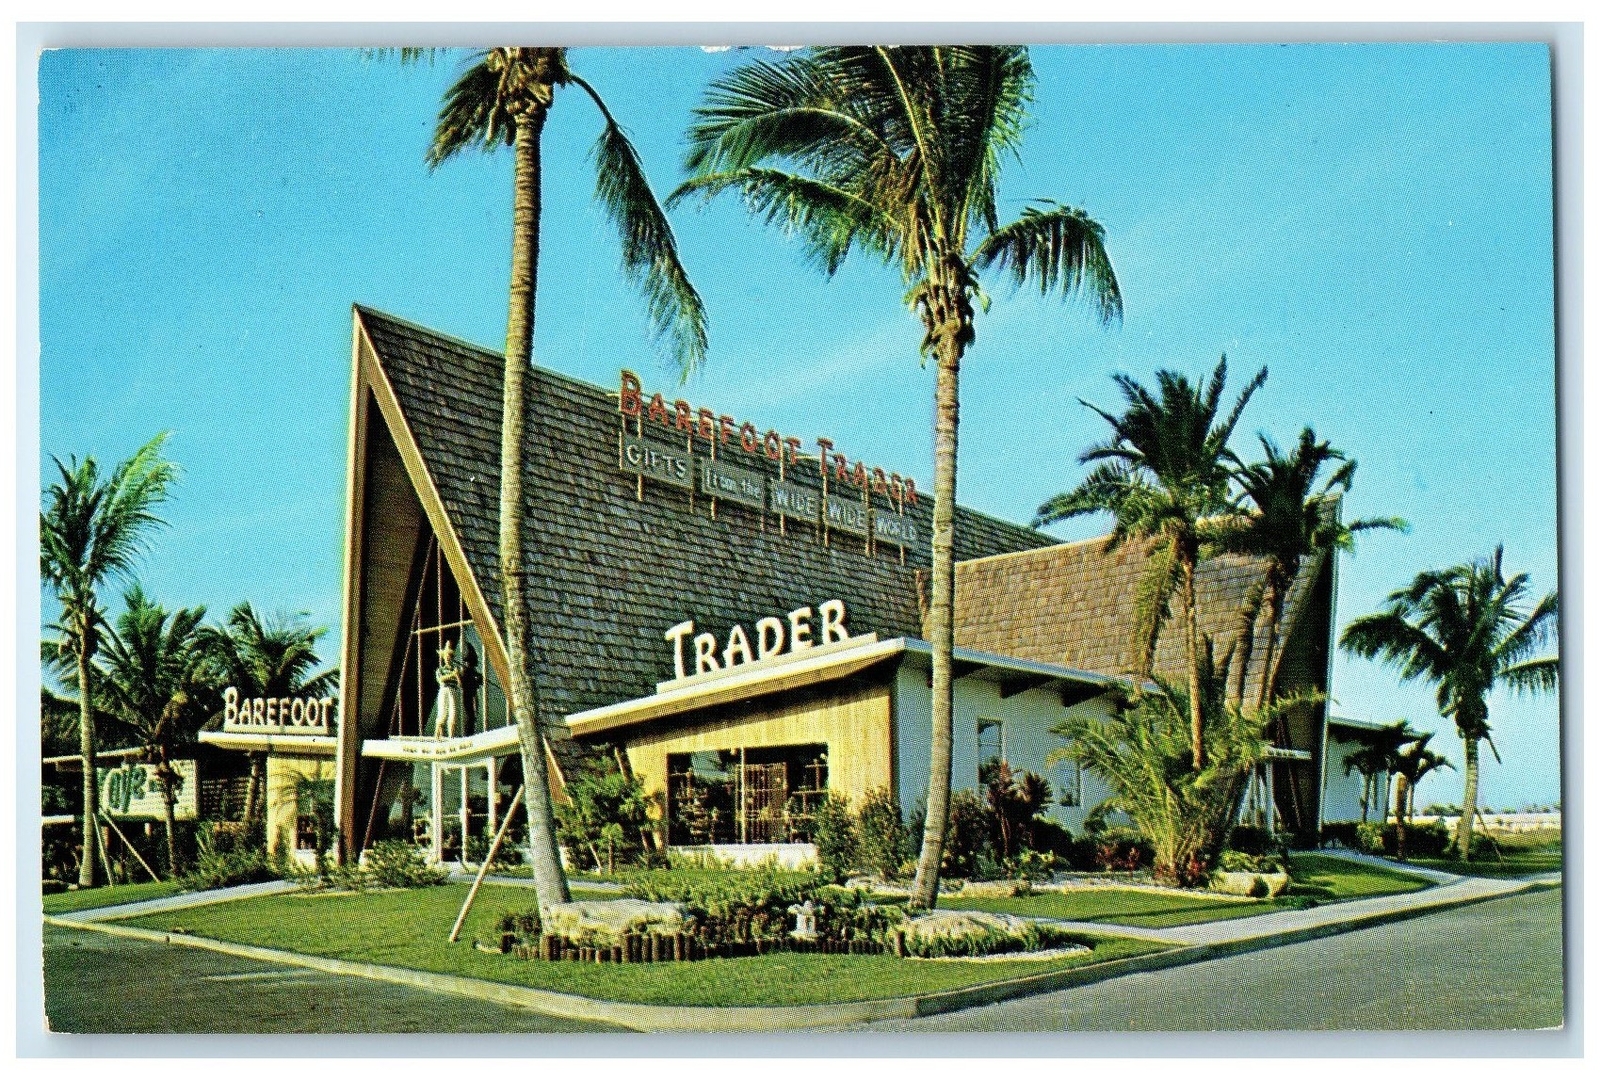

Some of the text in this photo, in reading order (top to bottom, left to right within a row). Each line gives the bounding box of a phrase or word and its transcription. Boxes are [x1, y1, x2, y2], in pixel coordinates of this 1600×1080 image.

[620, 369, 919, 505] BAREFOOT TRADER
[627, 444, 687, 478] GIFTS
[774, 488, 816, 515] WIDE
[828, 501, 866, 528] WIDE
[664, 599, 850, 681] TRADER
[224, 685, 333, 728] BAREFOOT
